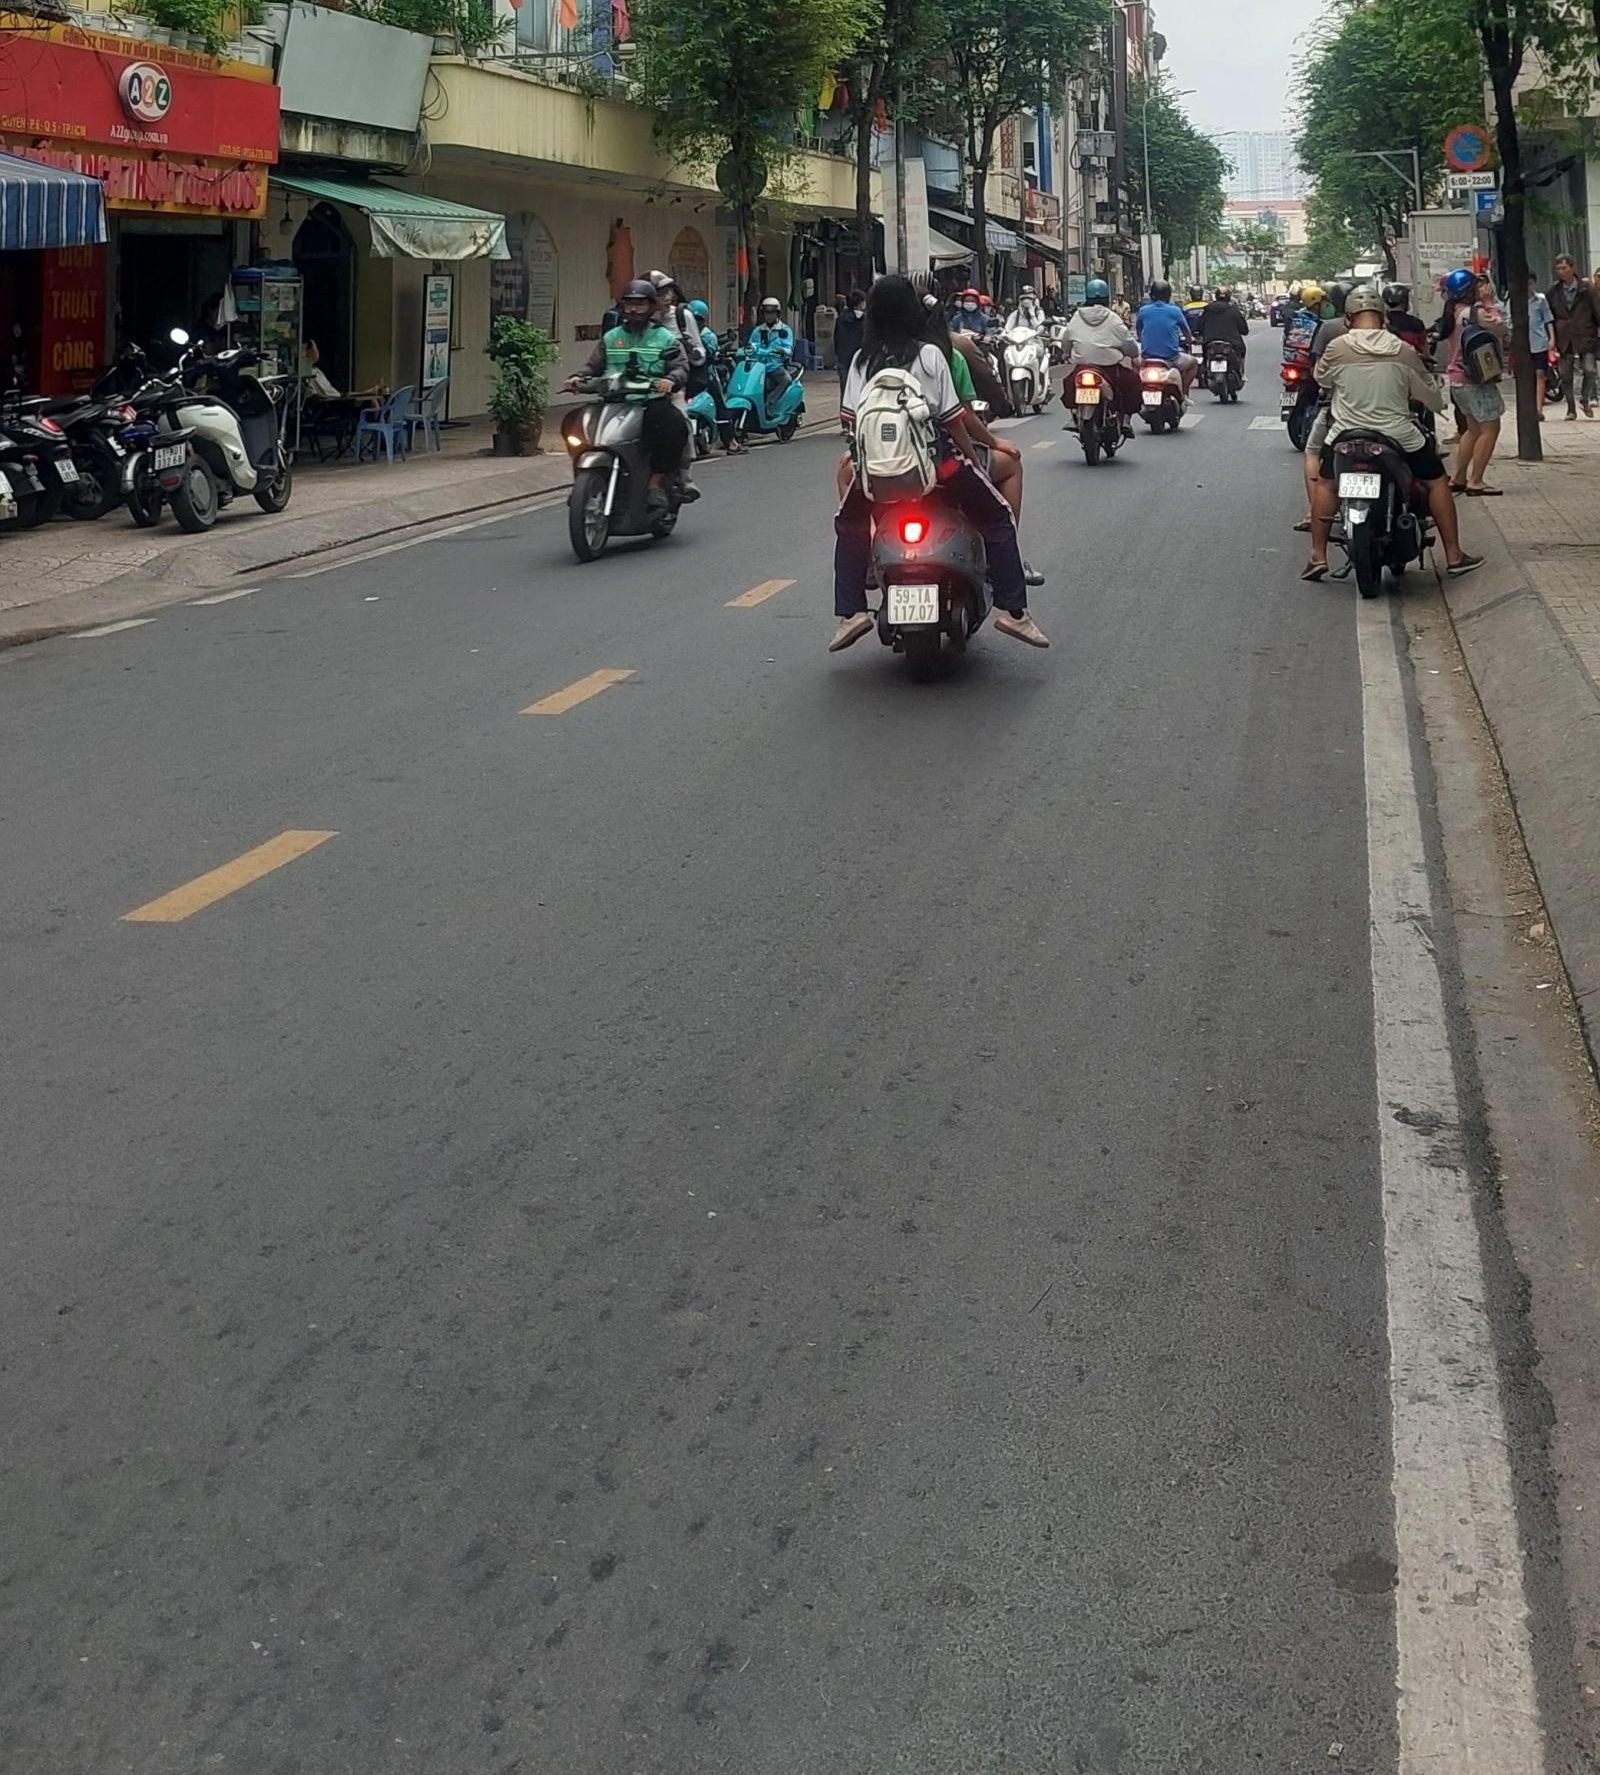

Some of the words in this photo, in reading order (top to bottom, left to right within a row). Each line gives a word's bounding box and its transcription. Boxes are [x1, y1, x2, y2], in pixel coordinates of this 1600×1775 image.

[130, 75, 169, 110] A2Z
[52, 285, 97, 323] THUẬT
[53, 335, 95, 371] CÔNG
[893, 605, 935, 622] 117.07
[896, 589, 931, 604] 59-TA
